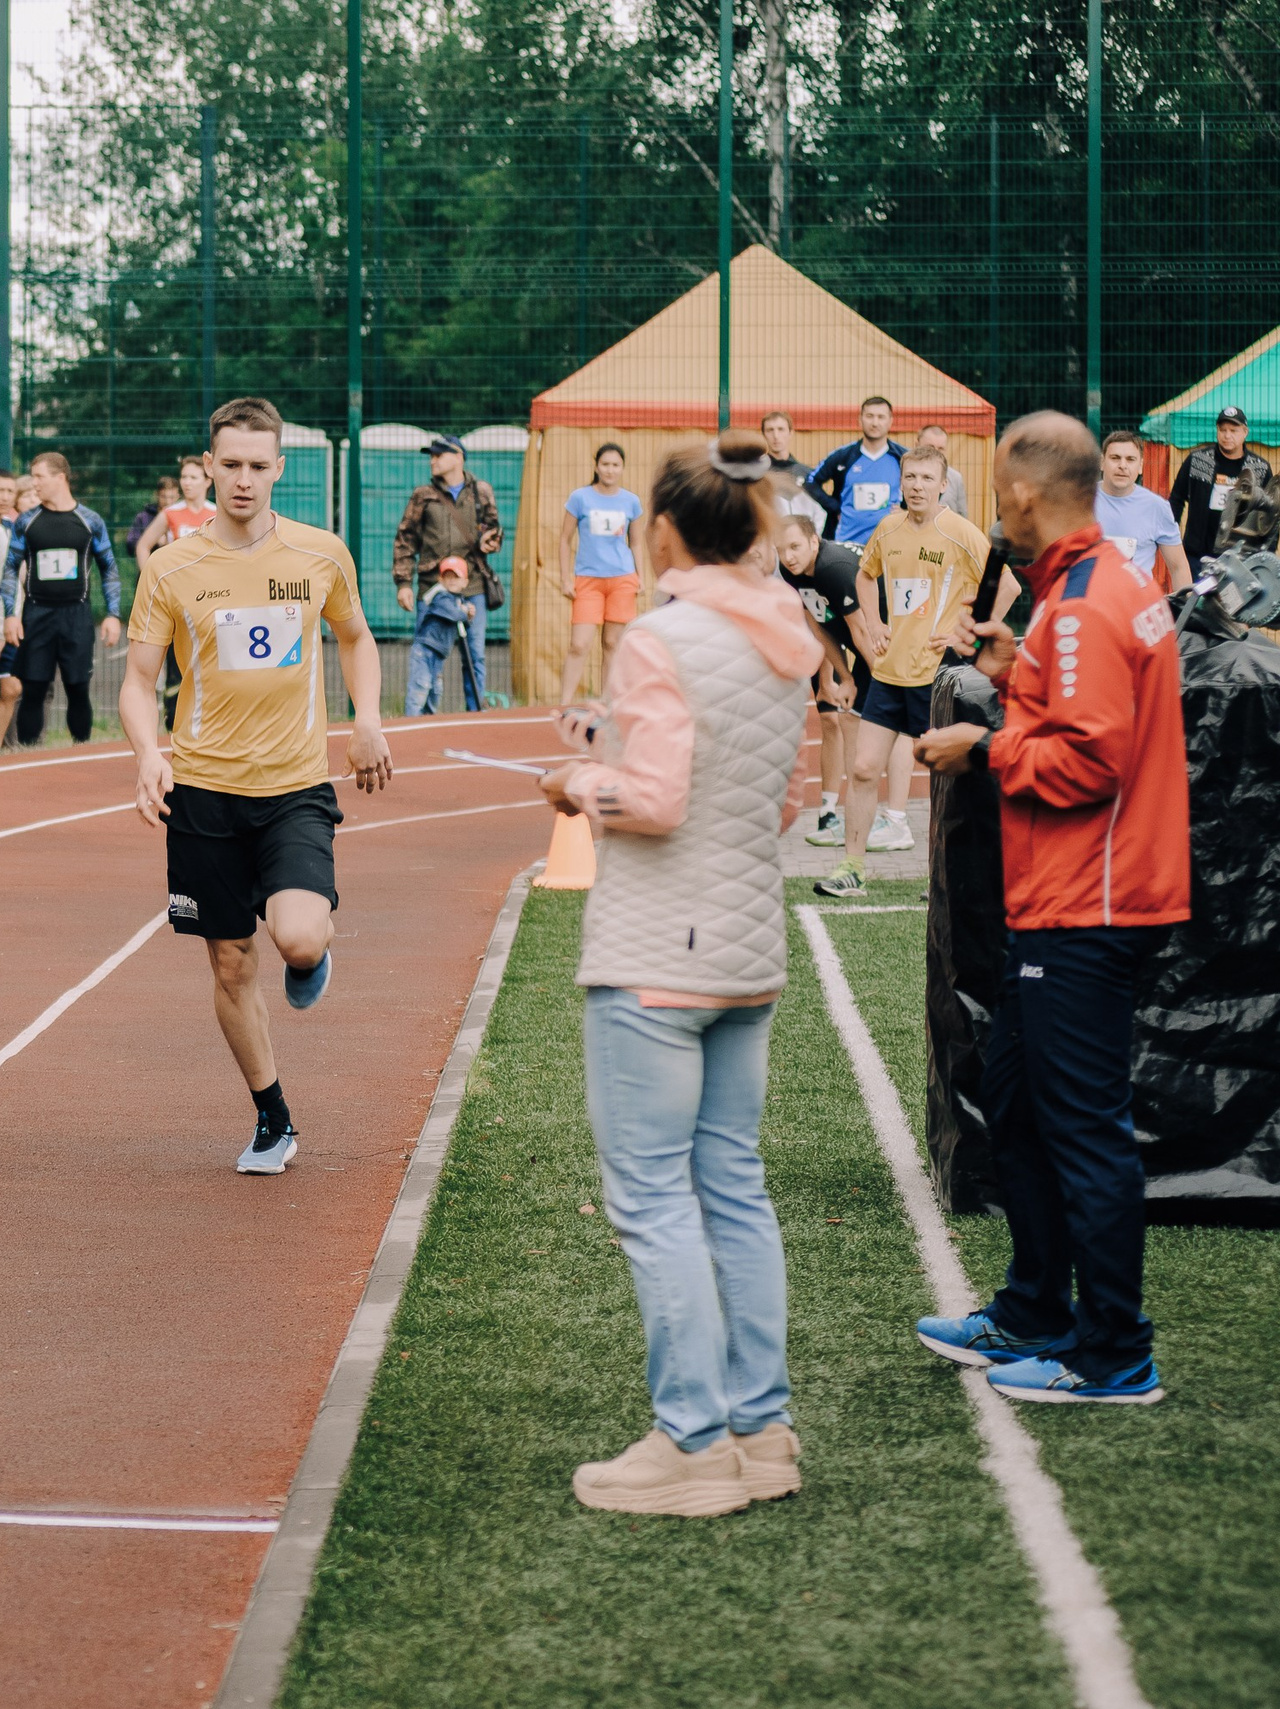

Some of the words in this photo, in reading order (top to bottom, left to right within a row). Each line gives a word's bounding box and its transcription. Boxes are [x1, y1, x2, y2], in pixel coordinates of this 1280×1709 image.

[866, 492, 876, 506] 3
[603, 518, 612, 532] 1
[52, 558, 62, 574] 1
[207, 589, 231, 599] asics
[248, 625, 272, 659] 8
[289, 650, 298, 663] 4
[169, 893, 199, 911] NIKE
